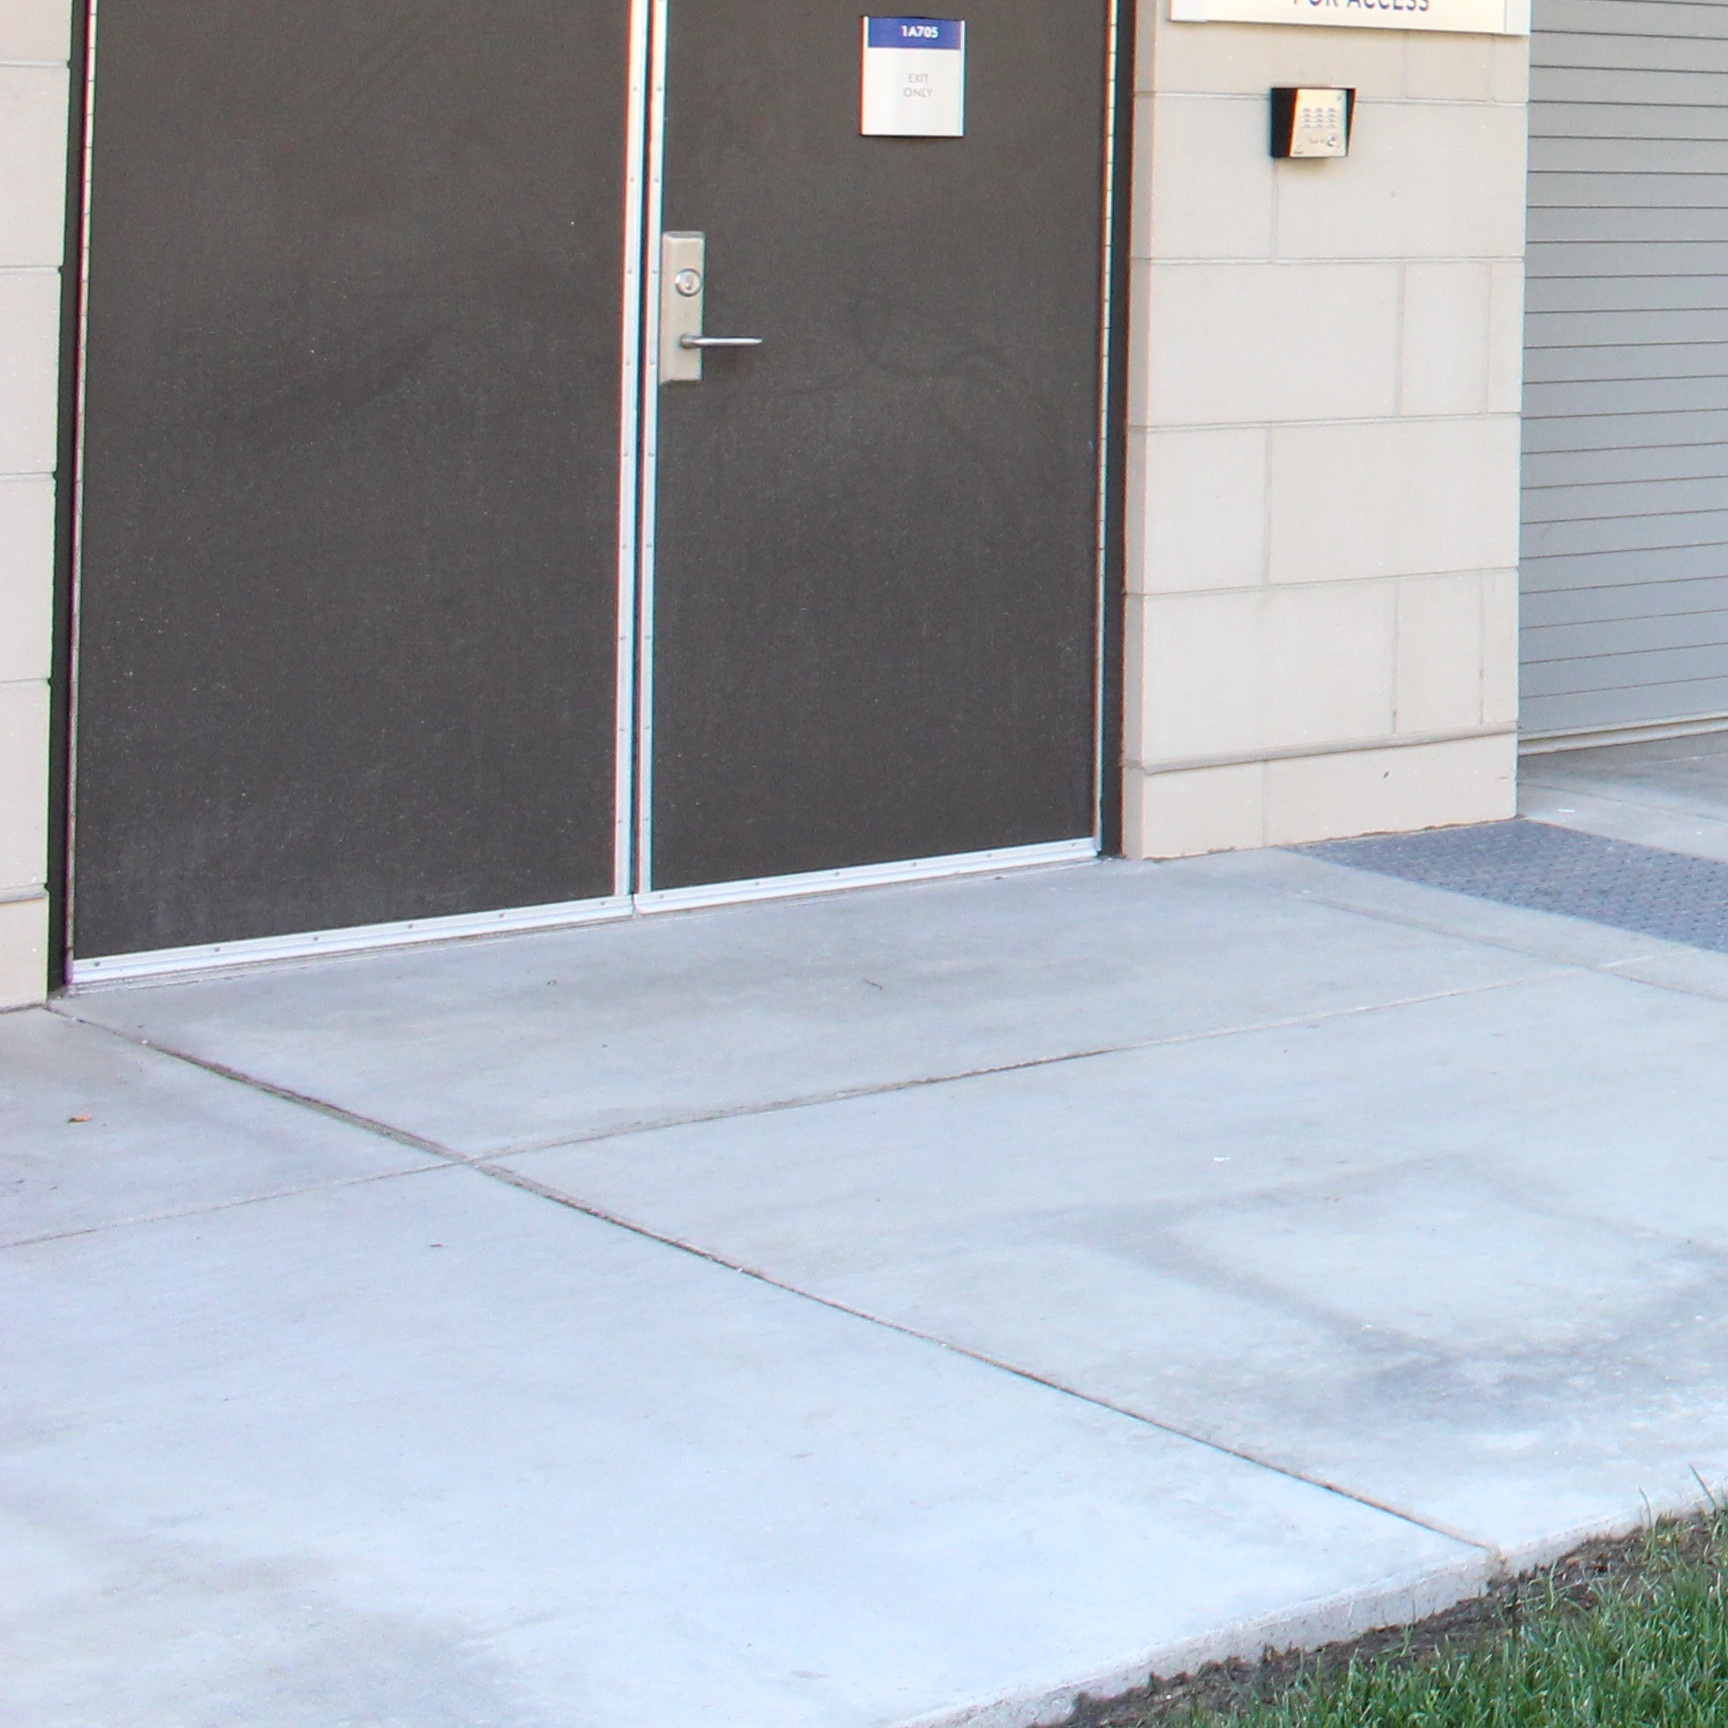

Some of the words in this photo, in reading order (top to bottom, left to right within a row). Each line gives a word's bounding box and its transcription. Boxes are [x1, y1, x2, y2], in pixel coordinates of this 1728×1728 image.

[902, 25, 939, 39] 1A705
[908, 73, 929, 84] EXIT
[903, 87, 933, 98] ONLY
